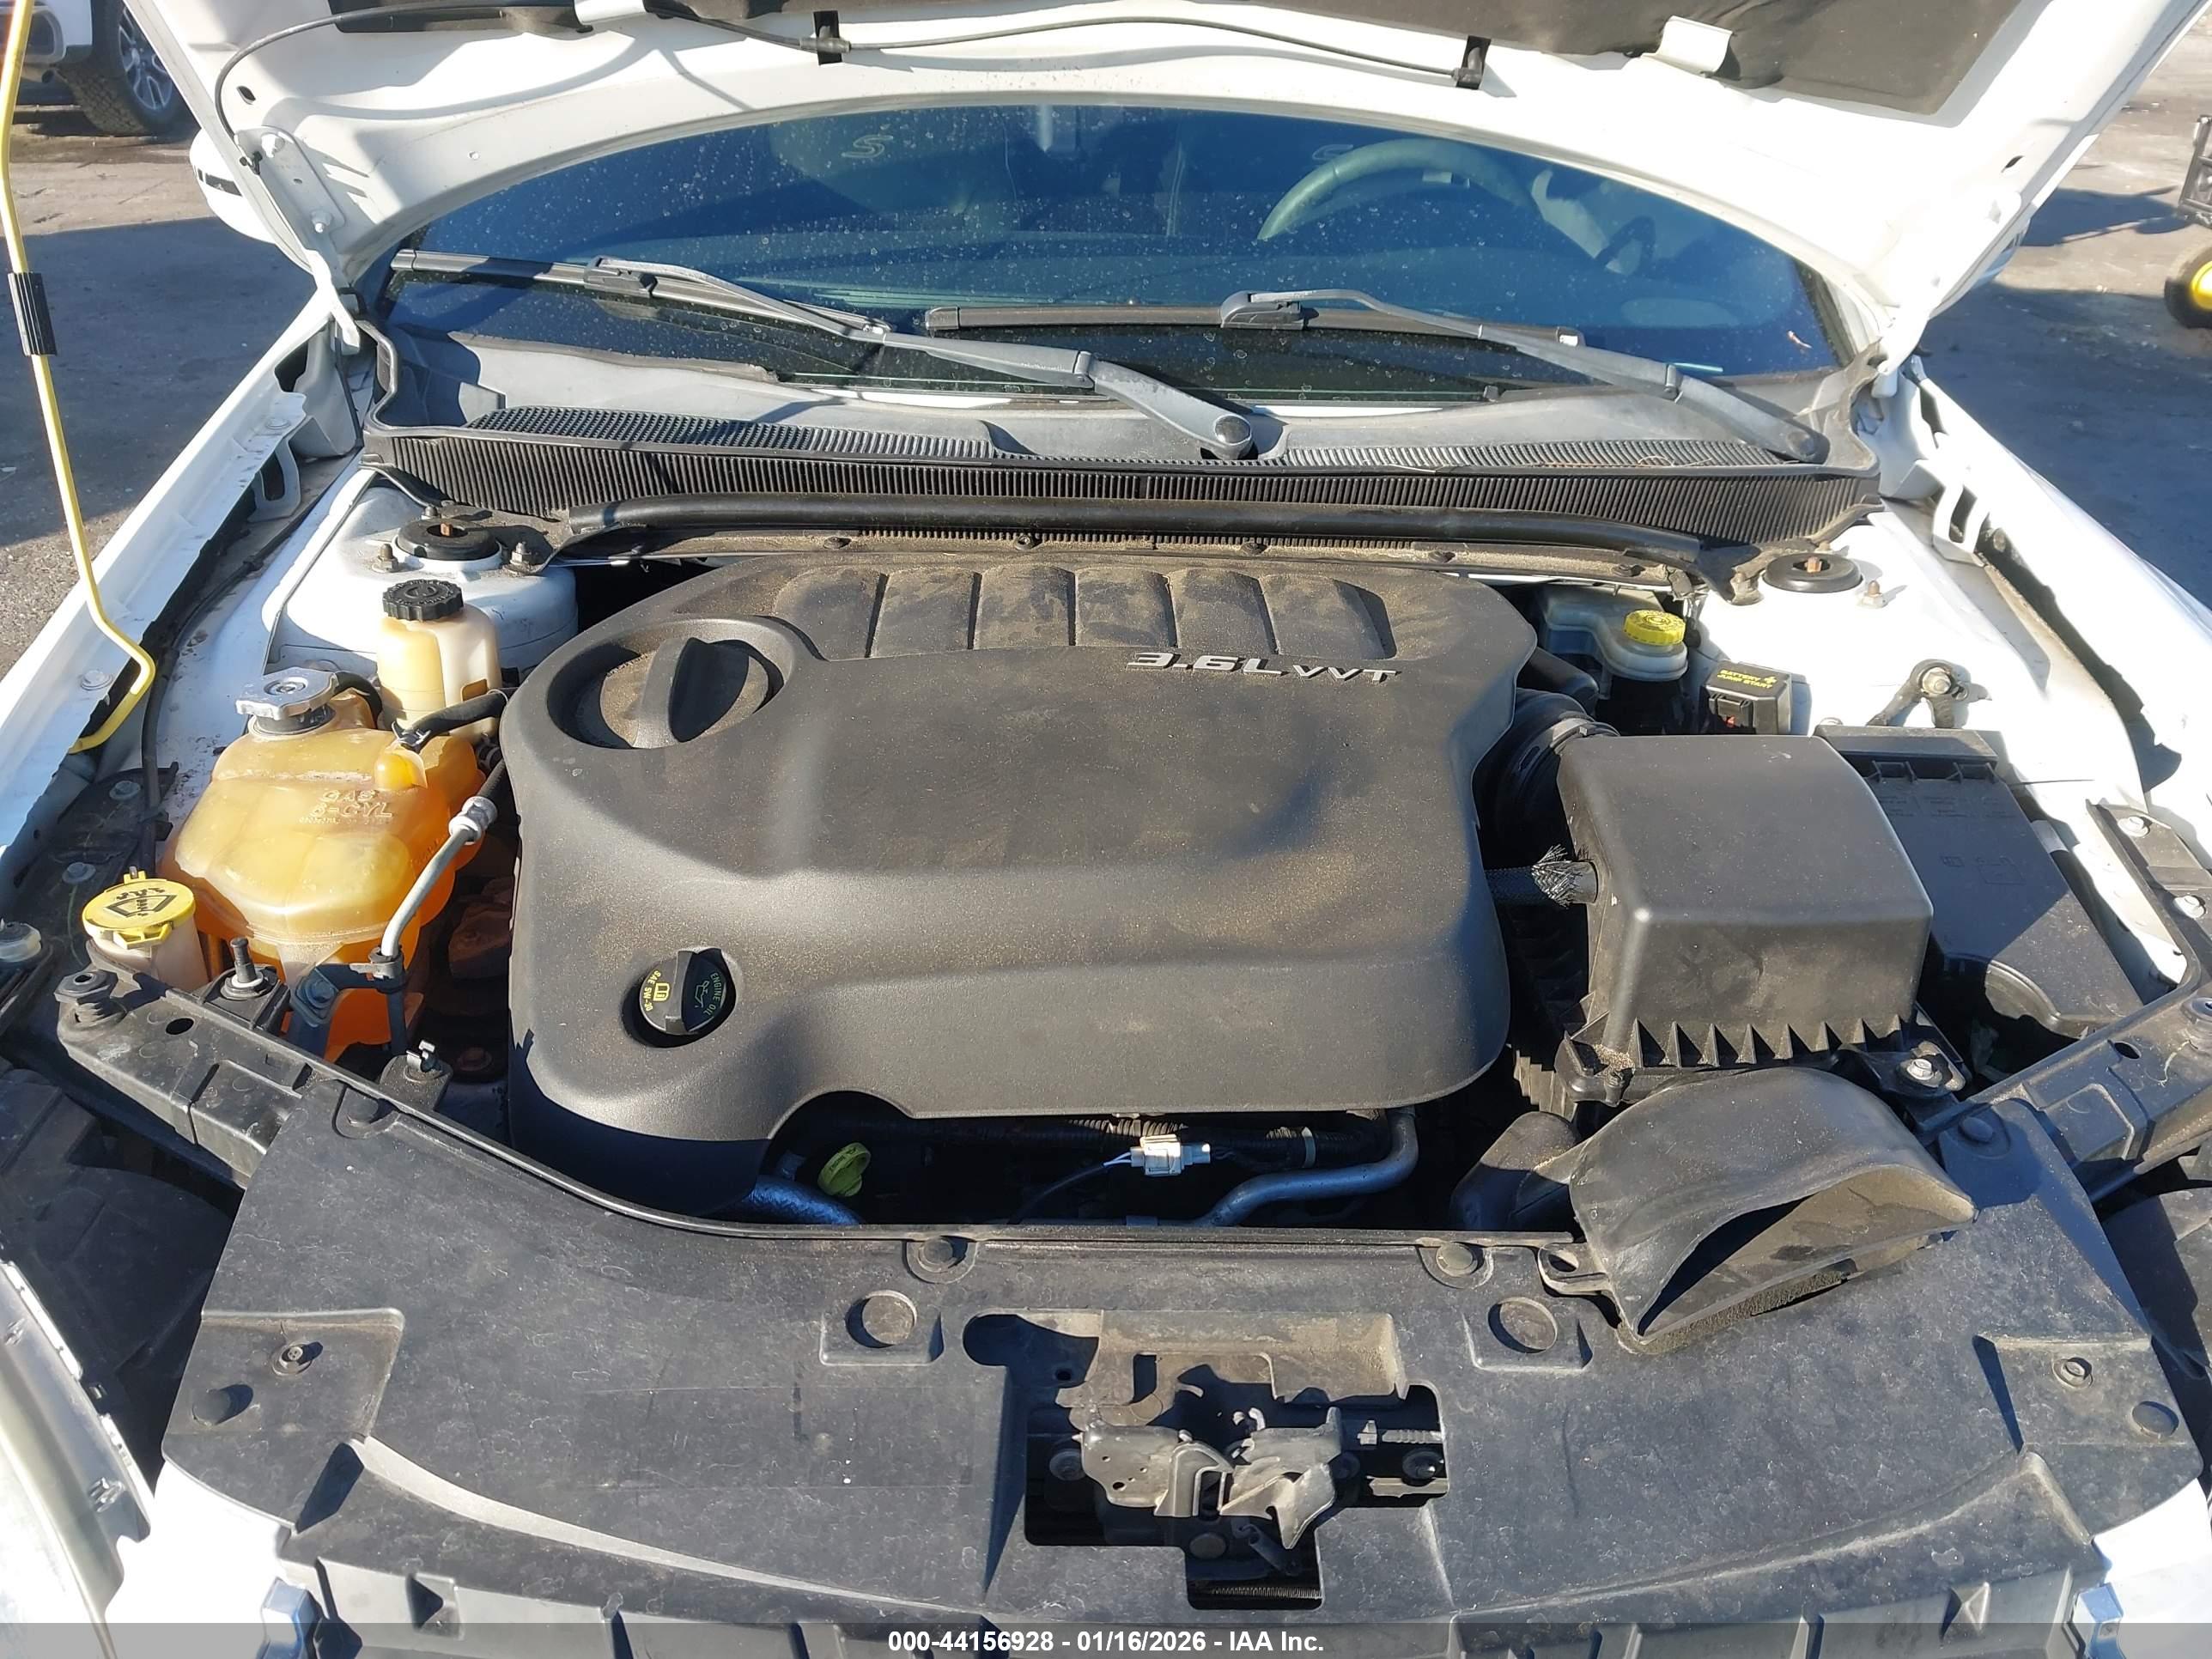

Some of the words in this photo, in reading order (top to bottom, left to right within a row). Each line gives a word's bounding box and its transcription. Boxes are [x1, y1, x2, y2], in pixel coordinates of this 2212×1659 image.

[1126, 652, 1283, 676] 3.6L
[1291, 664, 1398, 682] VVT
[1717, 673, 1743, 683] JUMP
[1742, 678, 1773, 689] START
[1719, 669, 1762, 682] BATTERY
[647, 969, 661, 985] SAE
[710, 972, 722, 1002] ENGINE
[642, 987, 653, 1012] 5W-30
[702, 1003, 716, 1017] OIL
